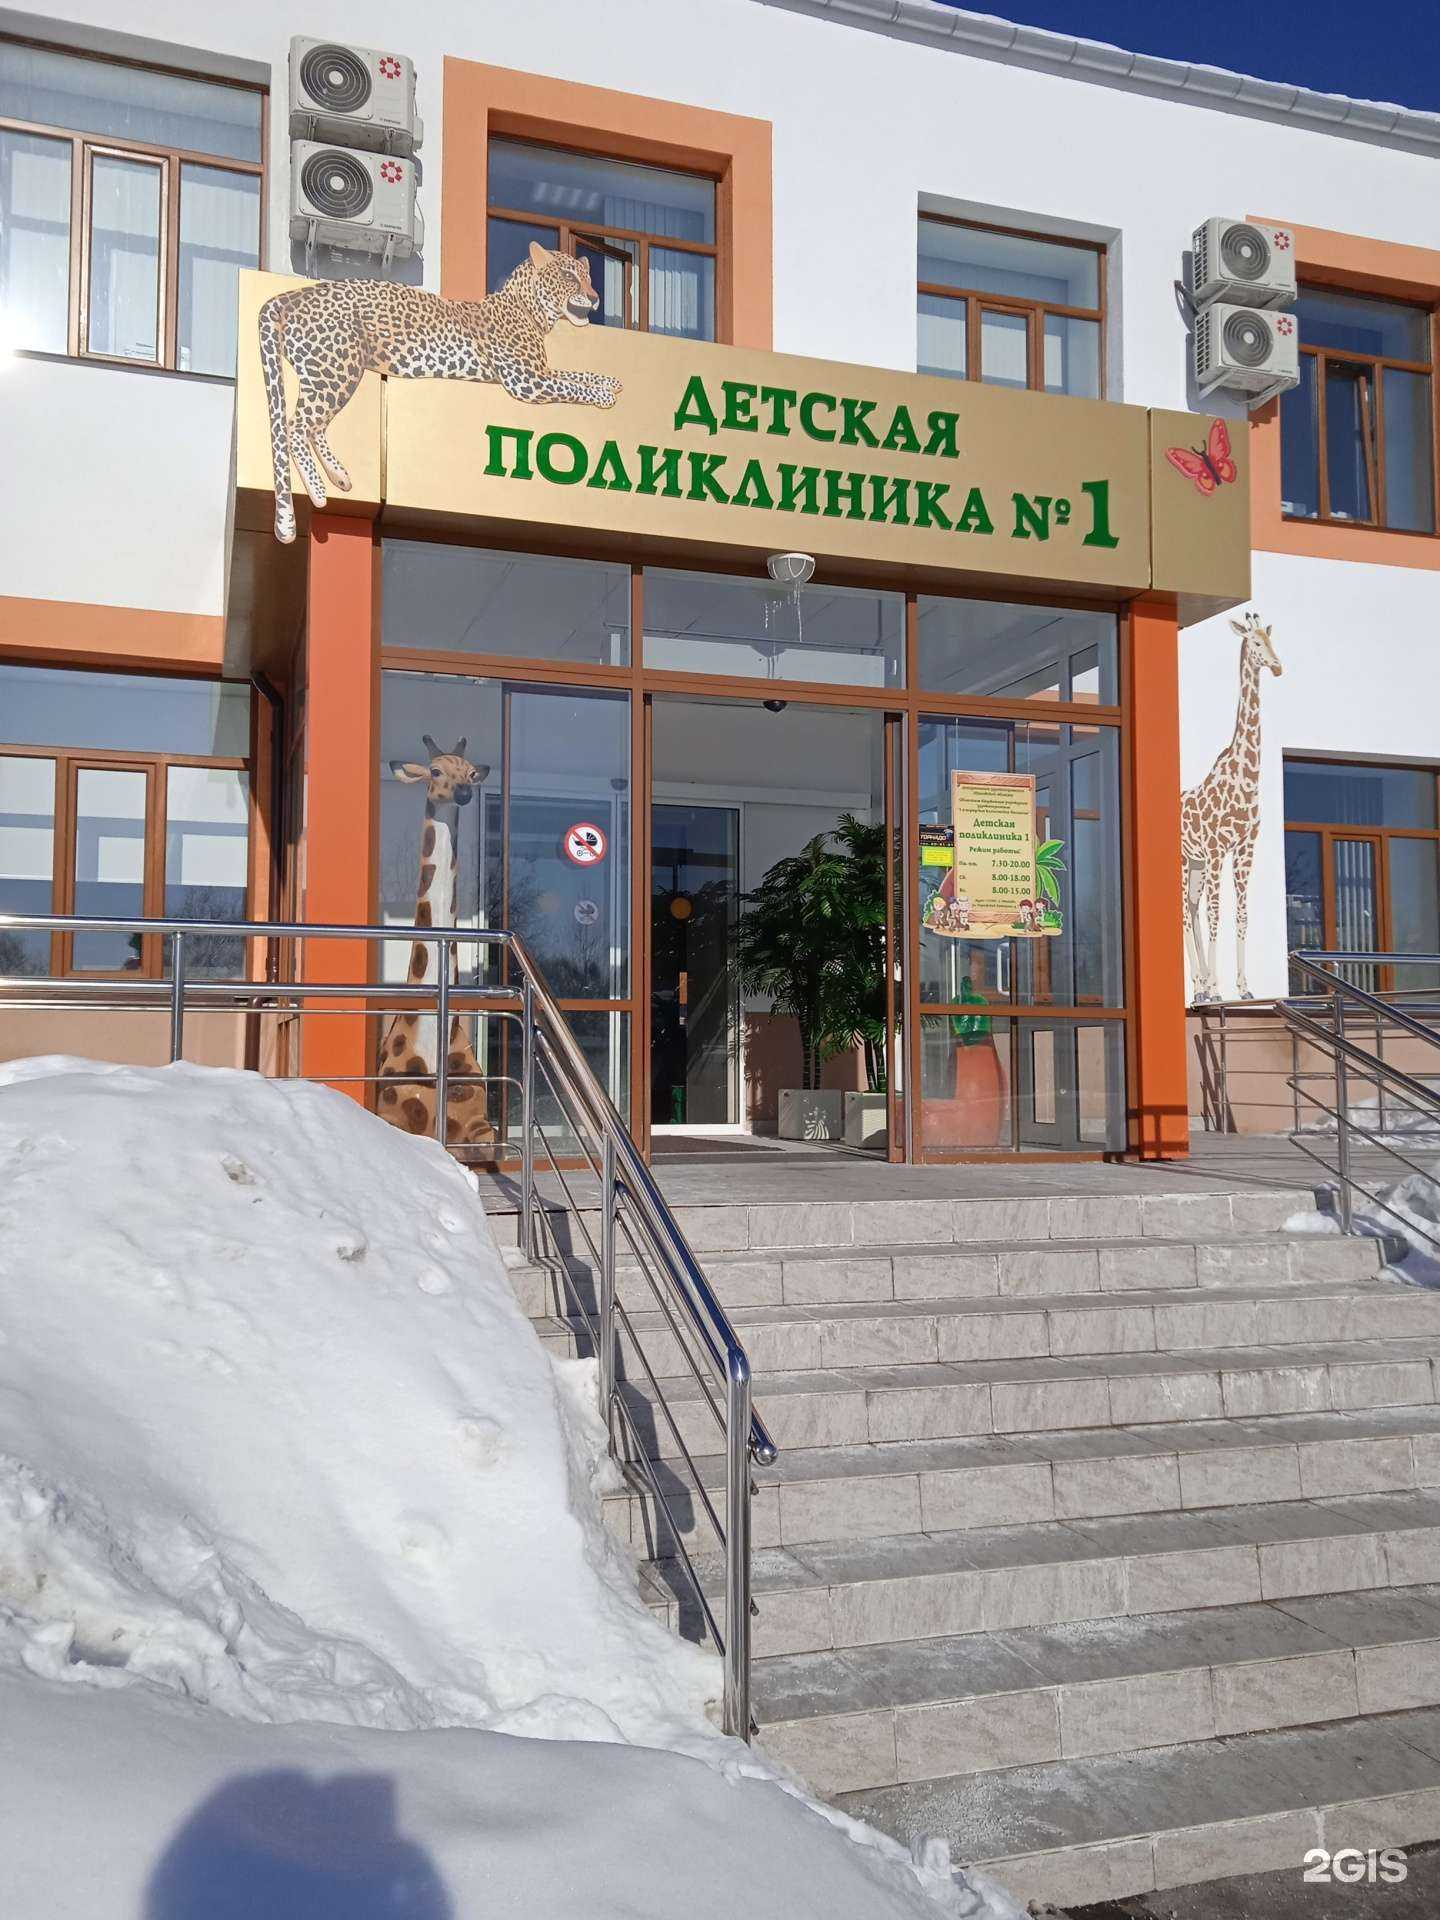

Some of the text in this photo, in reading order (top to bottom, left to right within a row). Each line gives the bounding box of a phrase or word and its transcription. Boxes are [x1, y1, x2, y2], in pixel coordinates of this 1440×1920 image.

[674, 375, 961, 459] ДЕТСКАЯ
[484, 424, 995, 535] ПОЛИКЛИНИКА
[959, 831, 1023, 841] поликлиника
[973, 817, 1016, 829] Детская
